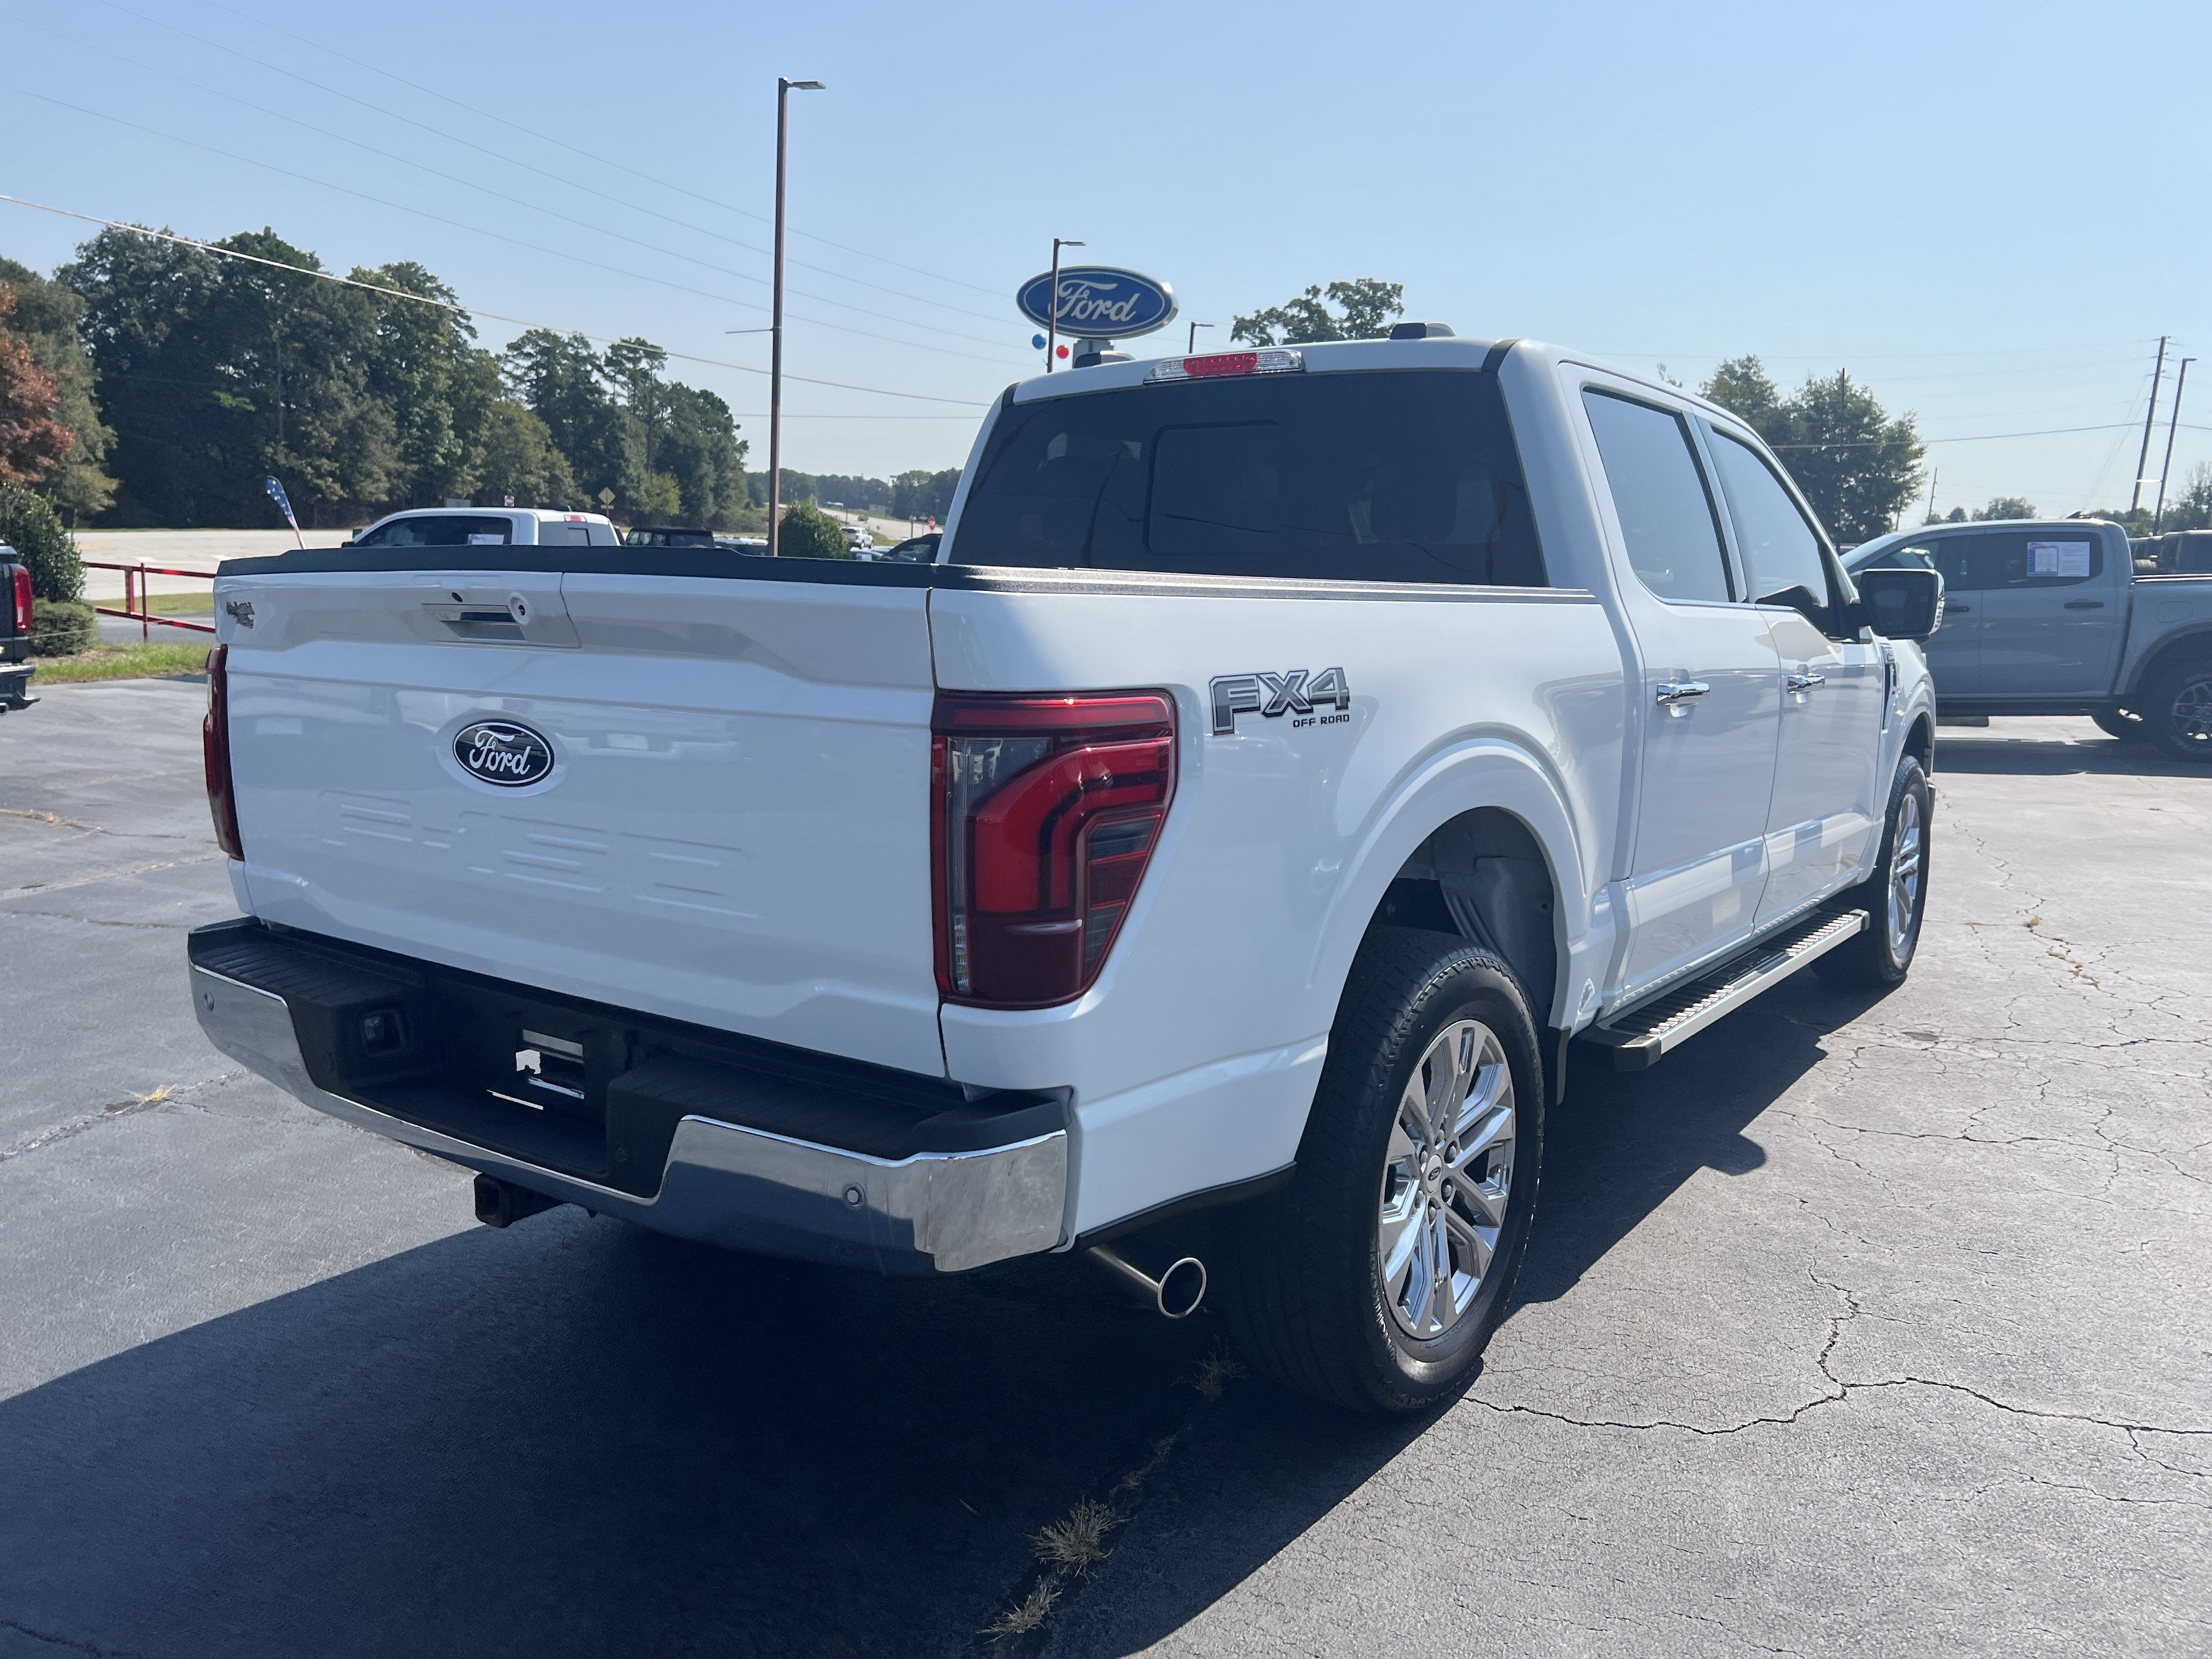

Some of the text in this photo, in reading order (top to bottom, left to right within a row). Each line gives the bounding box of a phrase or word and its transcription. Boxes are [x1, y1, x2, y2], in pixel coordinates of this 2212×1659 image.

[1048, 279, 1141, 321] Ford
[1209, 666, 1350, 736] FX4
[1293, 714, 1350, 728] OFF ROAD
[470, 730, 531, 775] Ford
